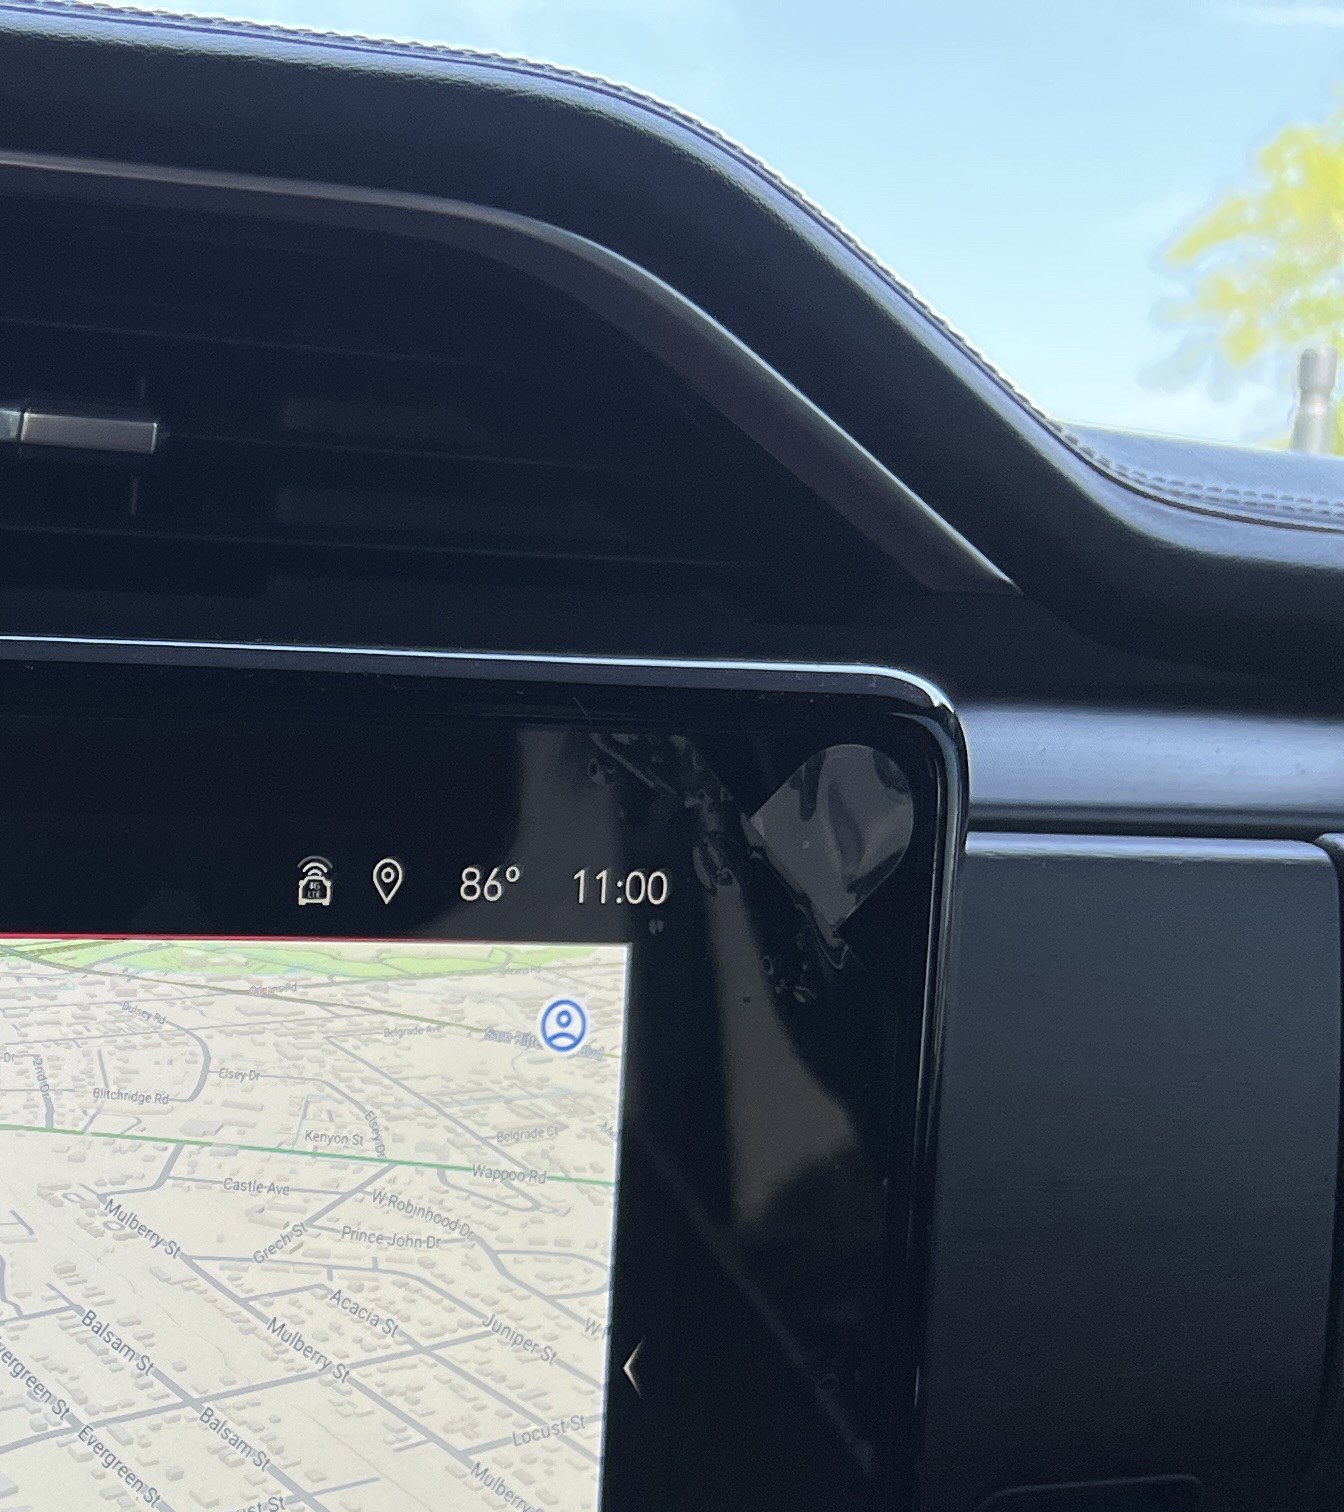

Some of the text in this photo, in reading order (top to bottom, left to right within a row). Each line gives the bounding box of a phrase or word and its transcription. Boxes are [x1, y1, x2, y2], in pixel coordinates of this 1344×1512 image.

[573, 868, 668, 904] 11:00
[92, 1087, 171, 1105] Blitchridge Rd
[305, 1129, 350, 1146] Kenyon
[223, 1177, 291, 1196] Castle Ave
[472, 1163, 547, 1184] Wappoo Rd
[105, 1197, 182, 1260] Mulberry St
[372, 1188, 476, 1240] W Robinhood Dr
[252, 1221, 307, 1264] Grech St
[341, 1225, 442, 1249] Prince John Dr
[329, 1289, 400, 1338] Acacia St
[583, 1317, 600, 1336] W
[81, 1309, 156, 1377] Balsam St
[266, 1315, 351, 1384] Mulberry St
[482, 1313, 559, 1367] Juniper St
[51, 1398, 71, 1421] St
[199, 1406, 271, 1472] Balsam St
[513, 1413, 587, 1447] Locust St
[77, 1423, 163, 1509] Evergreen St
